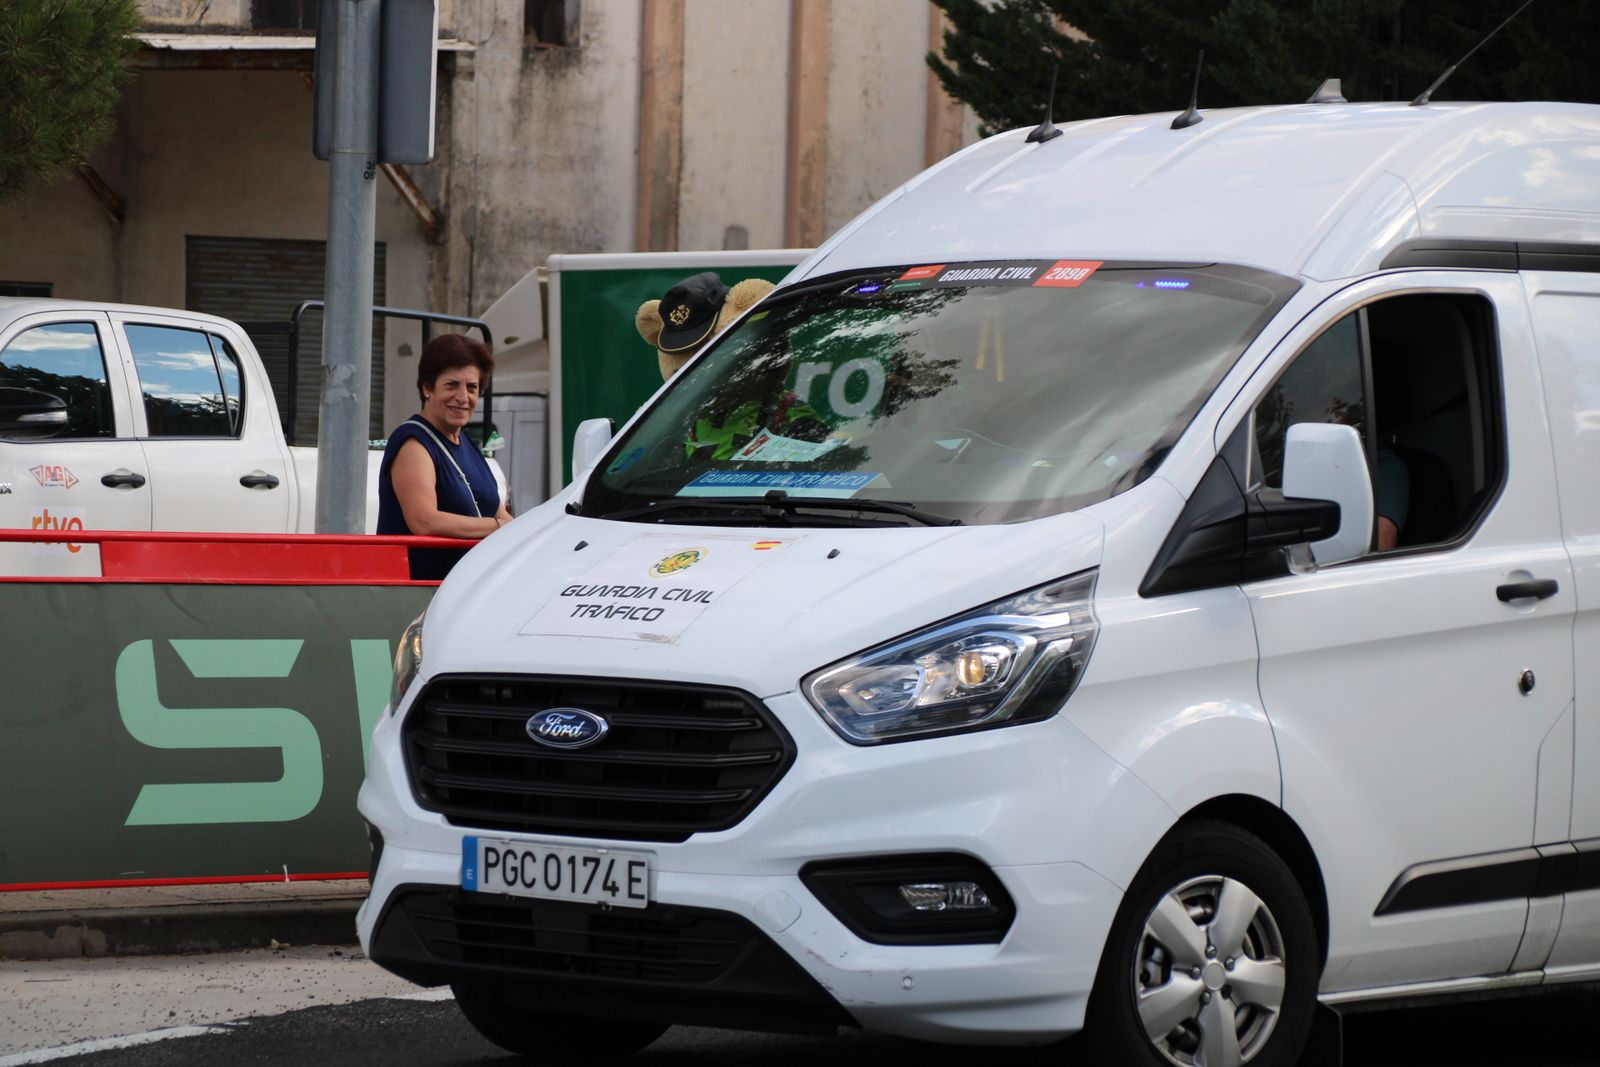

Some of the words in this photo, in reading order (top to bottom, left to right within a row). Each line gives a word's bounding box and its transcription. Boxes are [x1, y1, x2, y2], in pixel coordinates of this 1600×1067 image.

[938, 267, 1000, 282] GUARDIA
[998, 266, 1038, 280] CIVIL
[1045, 267, 1090, 281] 2898
[560, 584, 658, 599] GUARDIA
[662, 588, 715, 604] CIVIL
[569, 602, 665, 622] TRÁFICO
[538, 712, 586, 737] Ford
